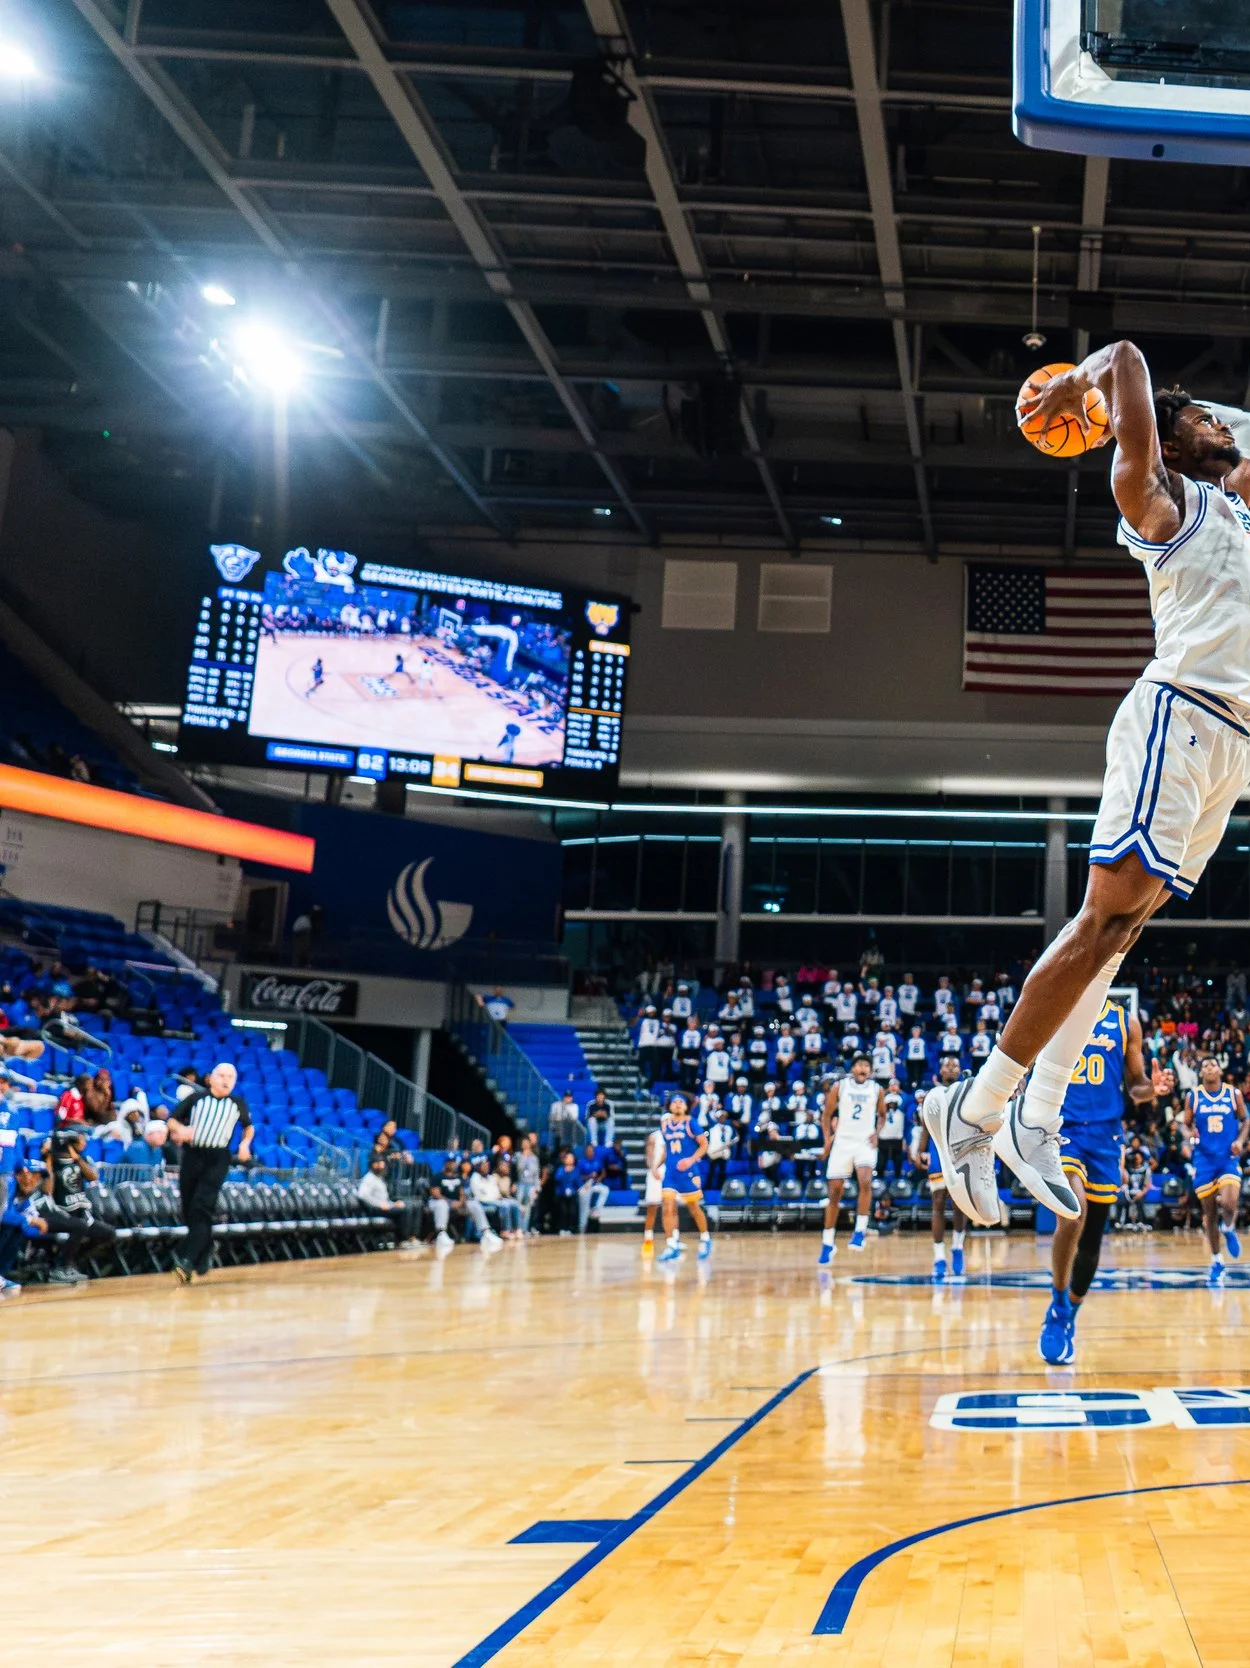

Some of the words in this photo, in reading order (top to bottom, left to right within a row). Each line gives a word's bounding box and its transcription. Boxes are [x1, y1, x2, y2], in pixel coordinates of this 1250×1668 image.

[358, 753, 384, 771] 62
[1070, 1053, 1104, 1085] 20
[852, 1103, 862, 1120] 2
